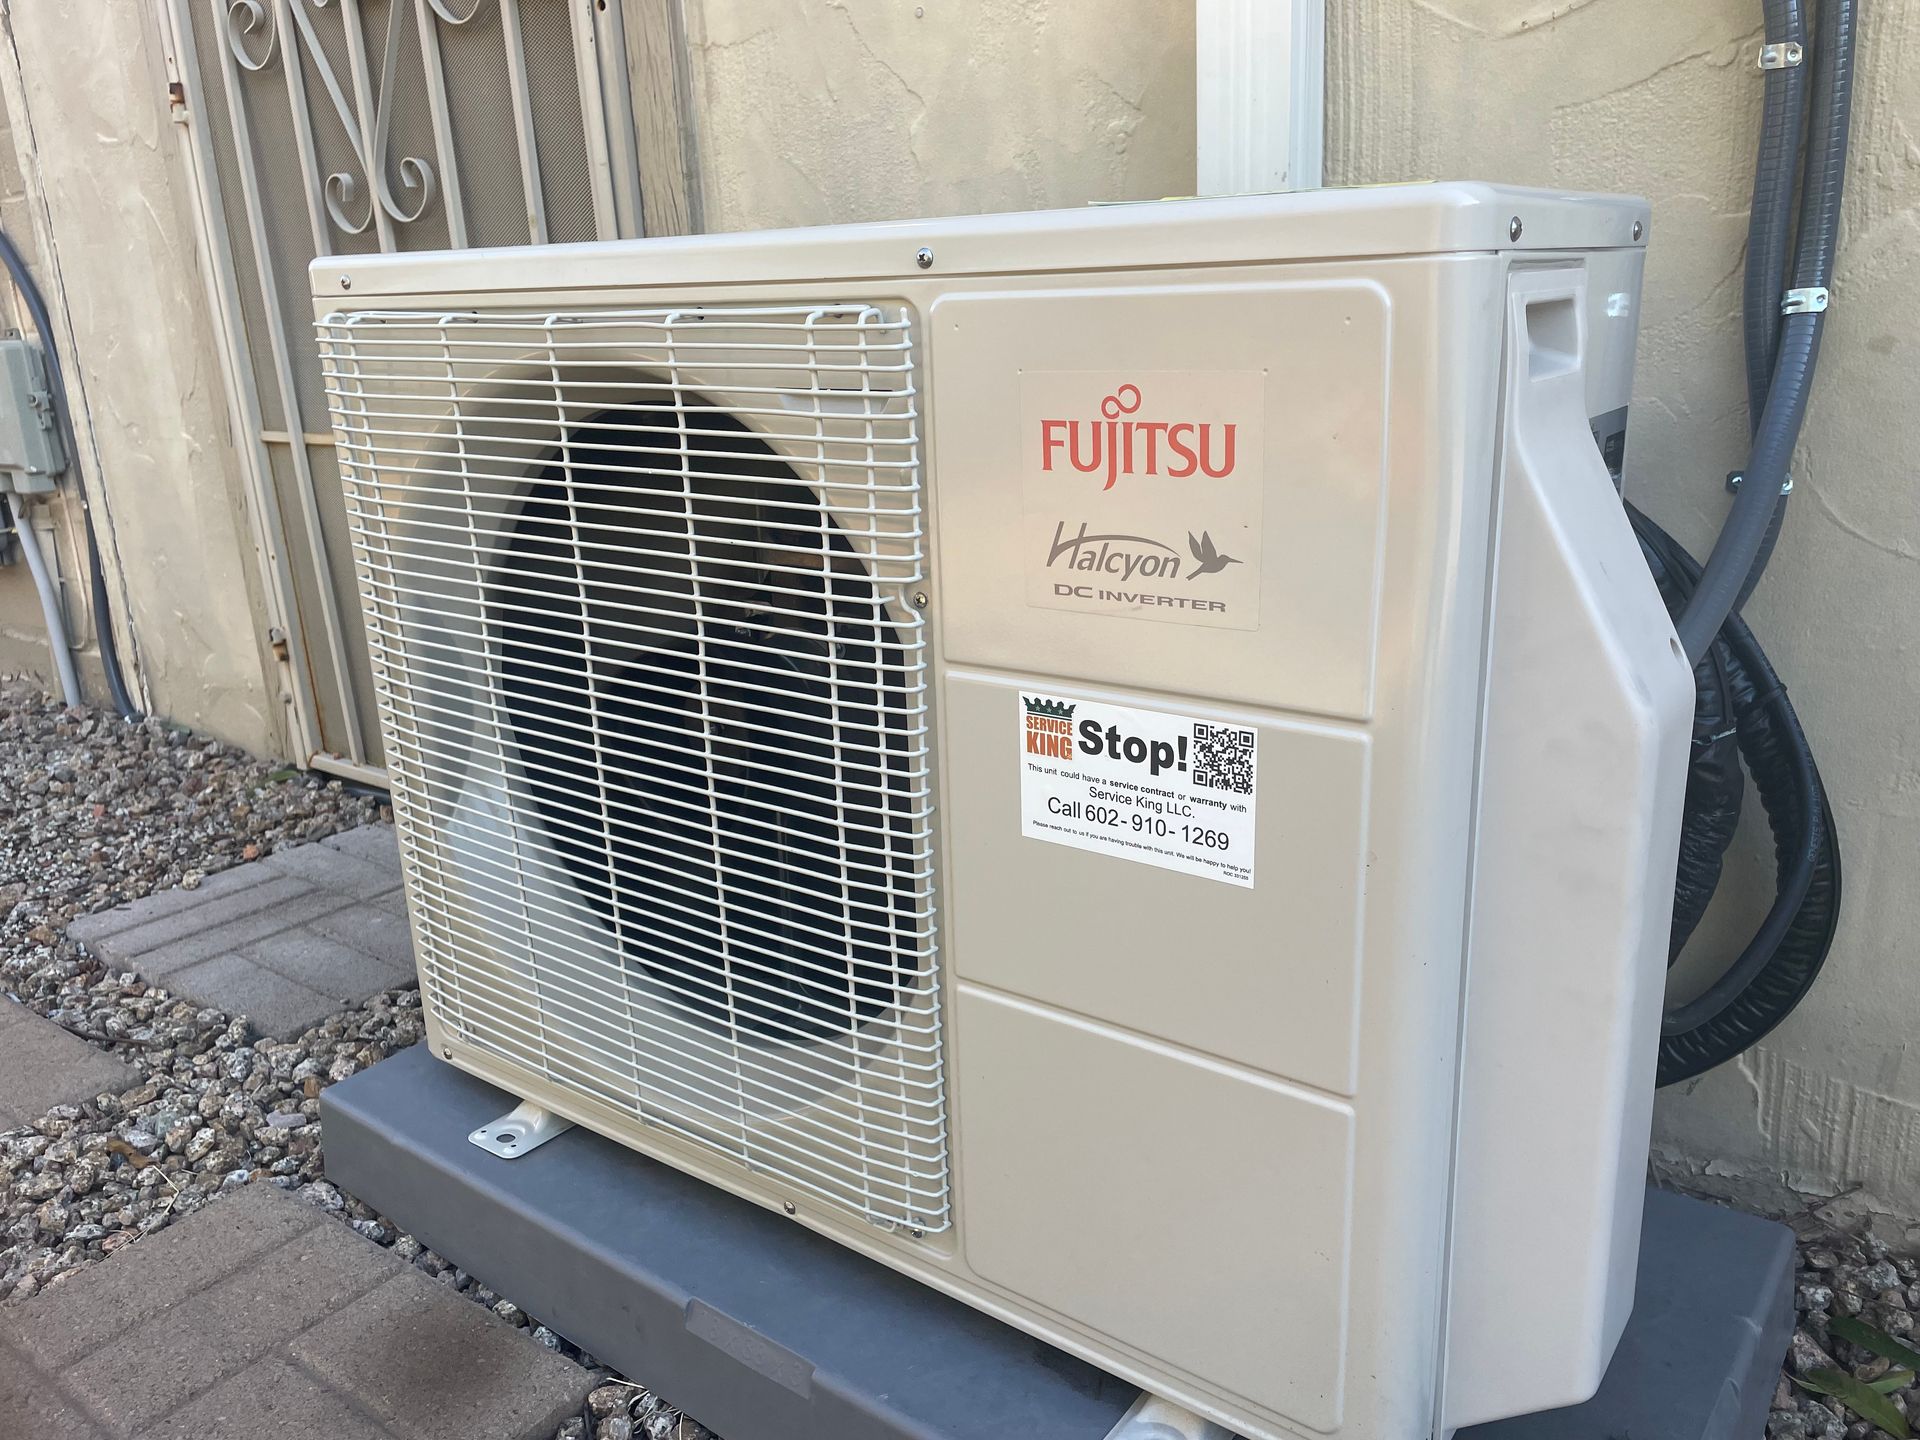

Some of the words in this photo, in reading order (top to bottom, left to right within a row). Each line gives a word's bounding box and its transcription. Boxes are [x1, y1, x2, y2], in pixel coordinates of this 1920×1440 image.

[1040, 418, 1237, 491] FUJITSU
[1046, 521, 1182, 581] Halcyon
[1054, 583, 1093, 599] DC
[1099, 590, 1226, 612] INVERTER
[1026, 715, 1072, 736] SERVICE
[1027, 731, 1072, 760] KING
[1078, 719, 1188, 776] Stop!
[1028, 763, 1043, 772] This
[1044, 767, 1057, 775] unit
[1060, 770, 1080, 780] could
[1082, 774, 1100, 784] have
[1109, 780, 1139, 791] service
[1140, 786, 1175, 799] contract
[1177, 793, 1186, 801] or
[1189, 796, 1227, 811] warranty
[1229, 803, 1247, 813] with
[1048, 796, 1081, 819] Call
[1089, 786, 1132, 805] Service
[1136, 795, 1163, 814] King
[1166, 801, 1195, 818] LLC.
[1032, 820, 1048, 828] Please
[1049, 824, 1062, 832] reach
[1108, 836, 1125, 846] having
[1125, 840, 1142, 849] trouble
[1143, 844, 1153, 852] with
[1176, 851, 1185, 859] We
[1203, 858, 1220, 868] happy
[1226, 863, 1239, 873] help
